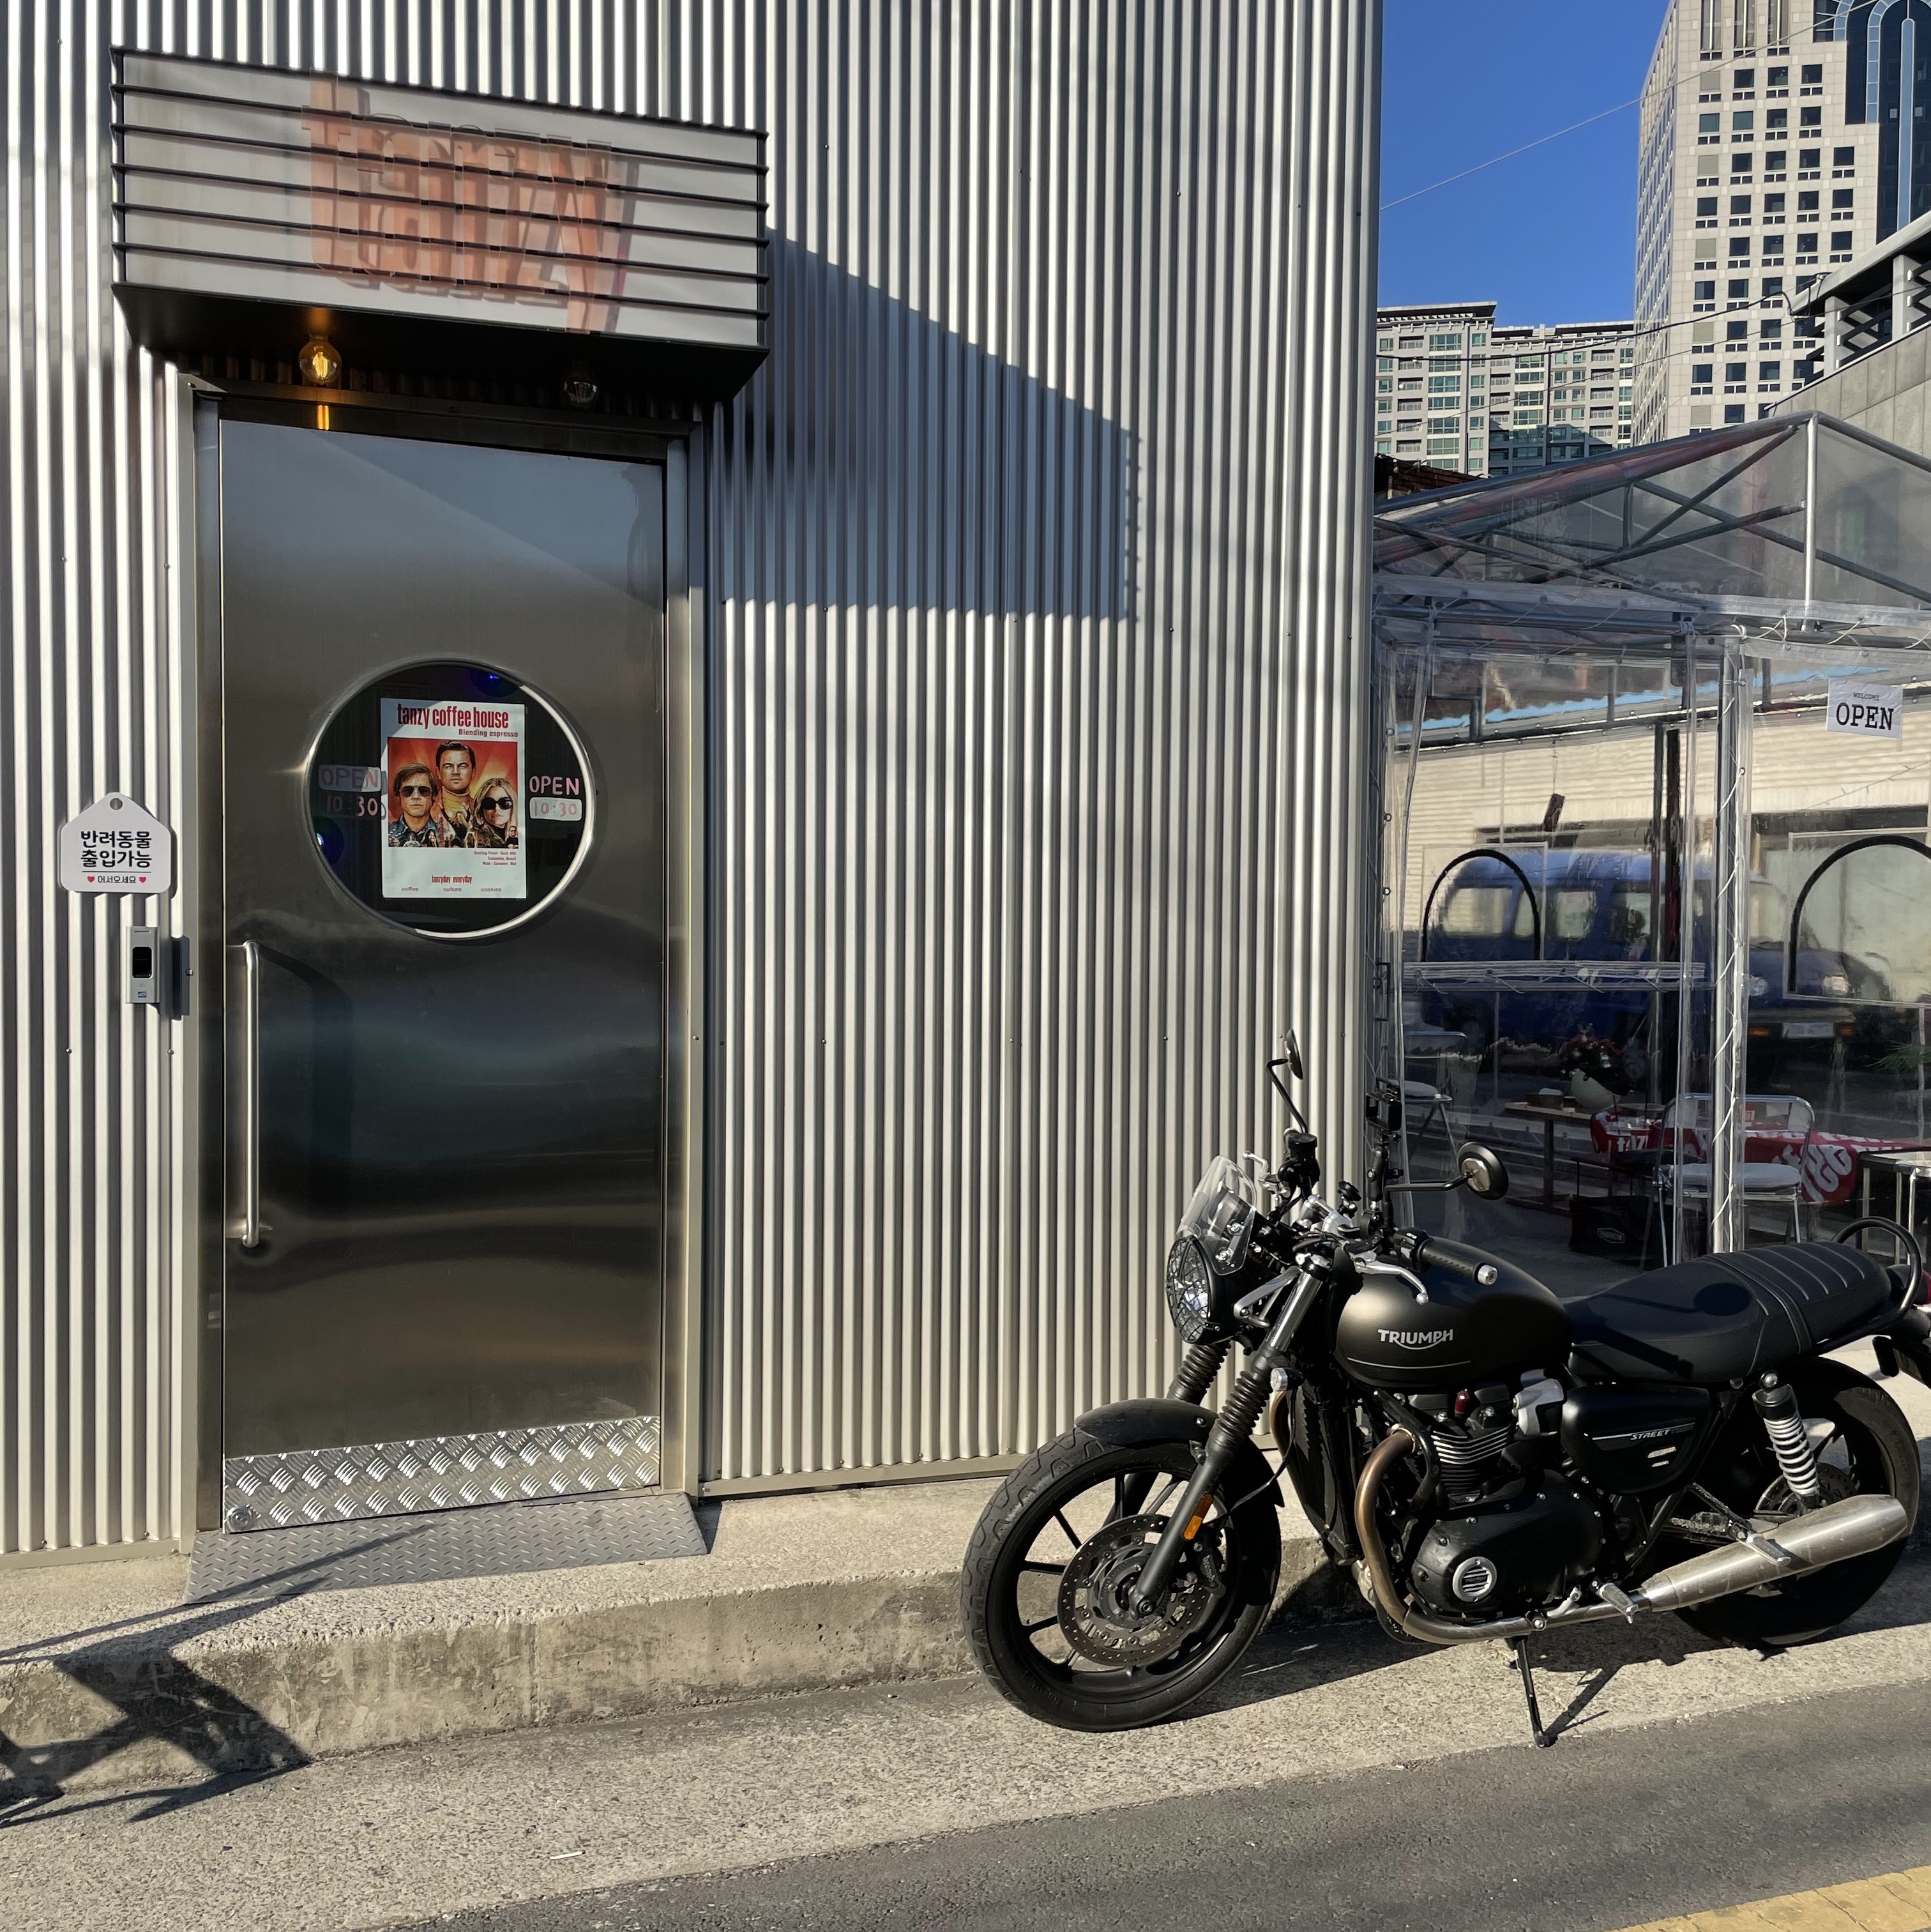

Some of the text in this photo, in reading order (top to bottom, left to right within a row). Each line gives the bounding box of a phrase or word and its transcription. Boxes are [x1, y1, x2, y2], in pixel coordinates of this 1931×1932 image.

[301, 69, 611, 334] tanzy
[1853, 692, 1880, 701] WELCOME
[397, 703, 509, 729] tanzy coffee house
[1836, 703, 1894, 731] OPEN
[458, 729, 487, 738] Blending
[321, 768, 379, 789] OPEN
[529, 775, 579, 796] OPEN
[534, 800, 578, 818] 10:30
[80, 830, 152, 849] 반려동물
[80, 849, 153, 868] 출입가능
[1377, 1328, 1454, 1350] TRIUMPH
[1630, 1429, 1671, 1441] STREET
